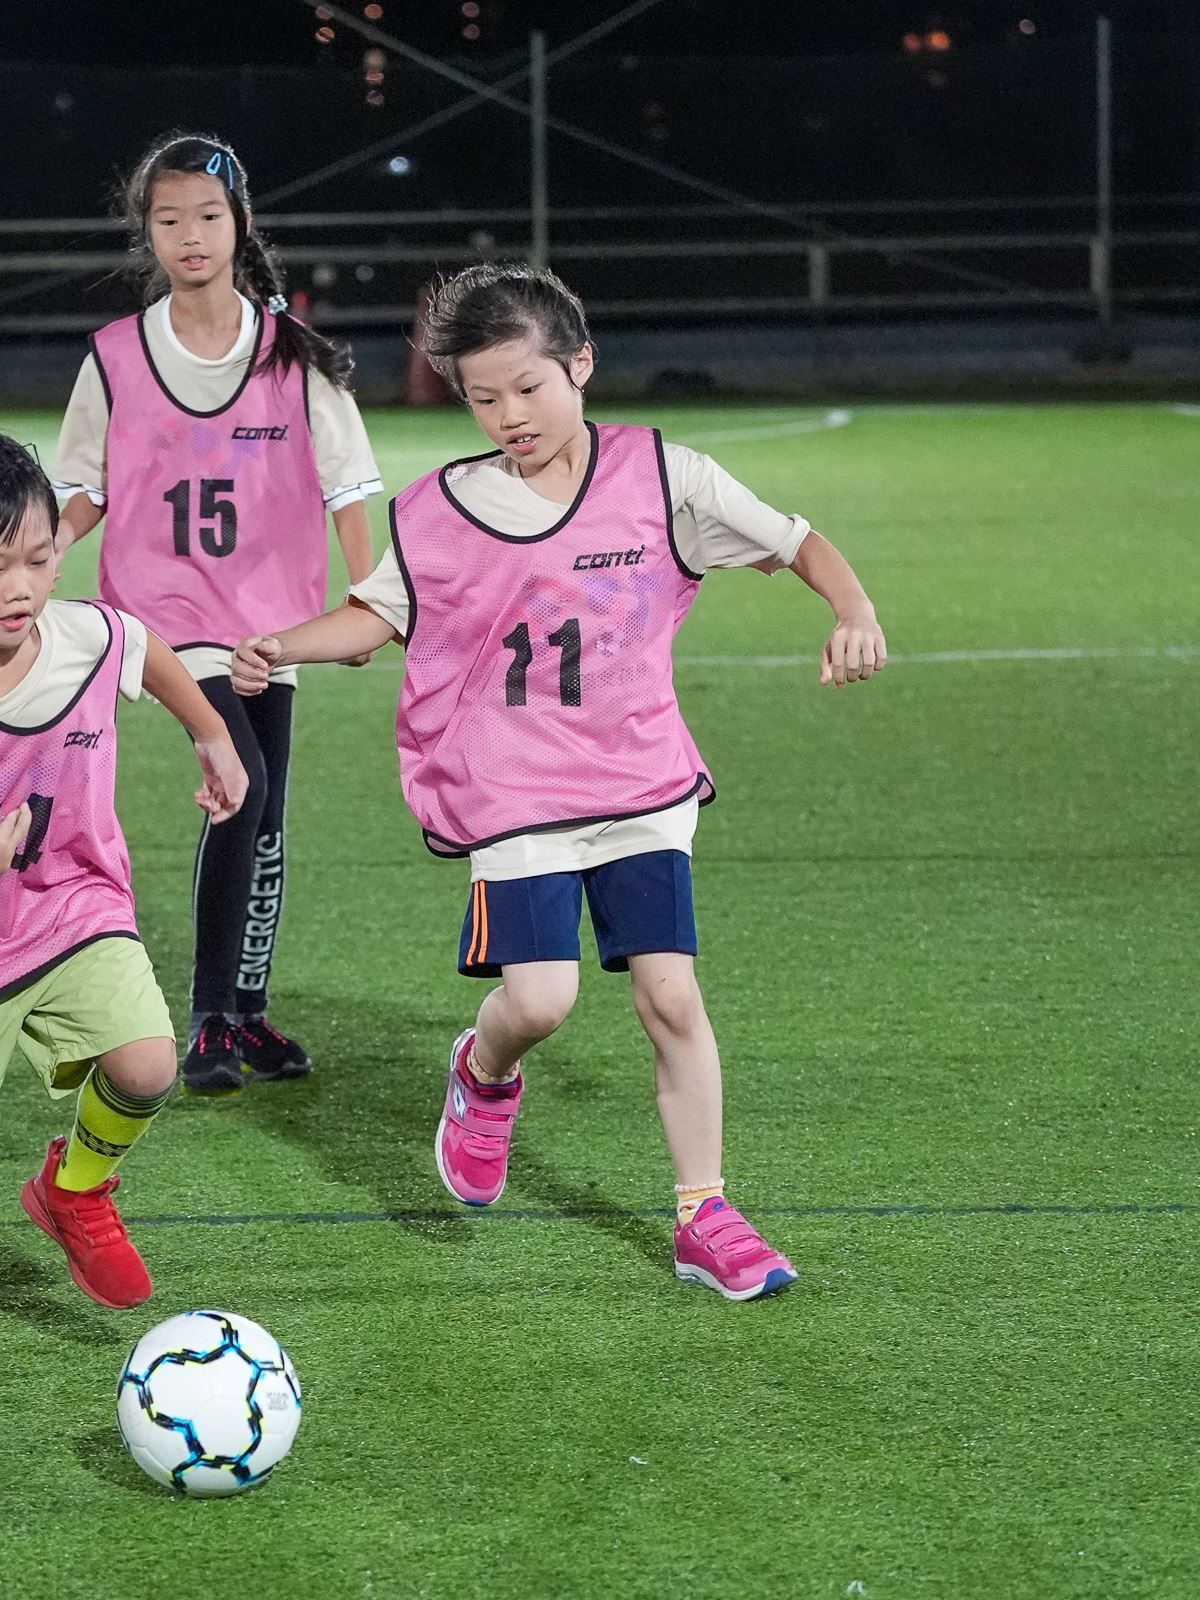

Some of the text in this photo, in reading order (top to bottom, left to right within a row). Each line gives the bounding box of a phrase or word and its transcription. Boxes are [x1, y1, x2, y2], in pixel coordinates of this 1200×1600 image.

[163, 479, 237, 557] 15
[573, 545, 645, 570] conti
[502, 618, 581, 706] 11
[236, 831, 281, 992] ENERGETIC
